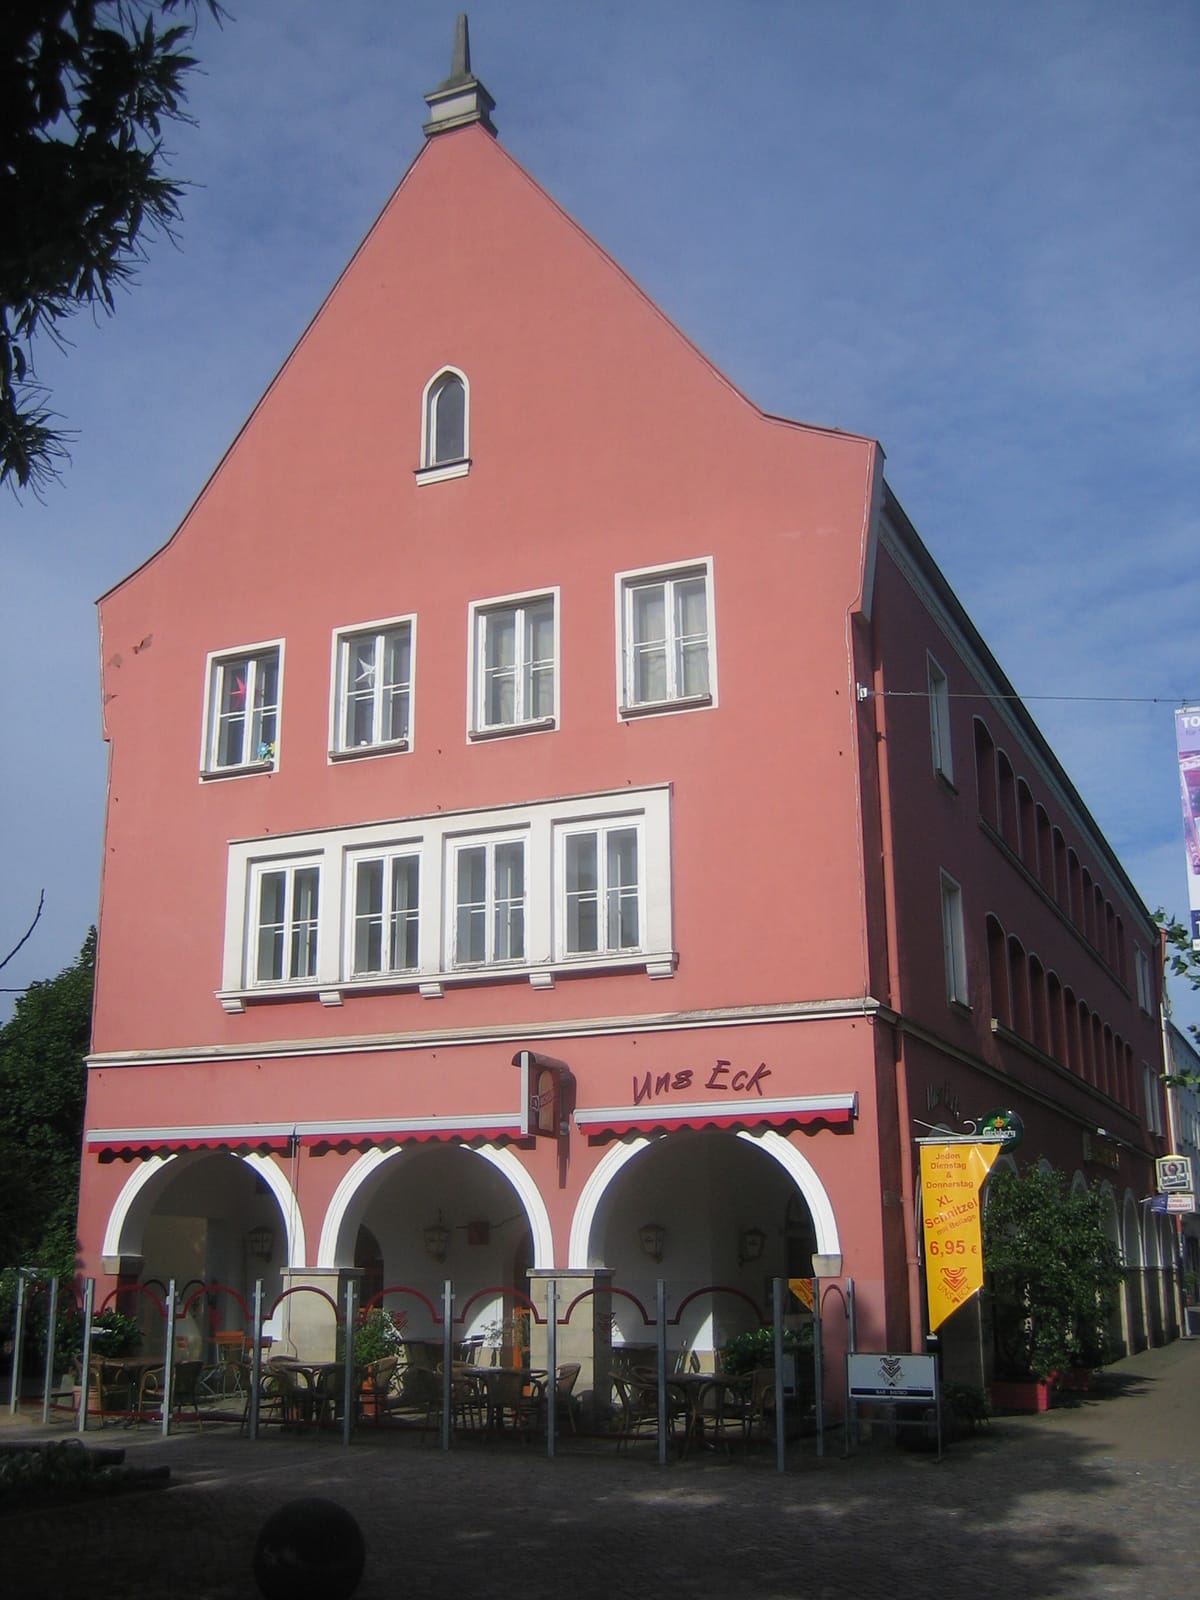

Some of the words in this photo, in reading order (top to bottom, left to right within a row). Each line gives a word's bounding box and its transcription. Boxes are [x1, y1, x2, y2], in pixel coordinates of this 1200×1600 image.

[633, 1069, 694, 1106] Uns
[705, 1059, 772, 1096] Eck
[982, 1126, 1016, 1139] Carlsberg
[935, 1152, 961, 1160] Jeden
[930, 1162, 967, 1170] Dienstag
[926, 1180, 974, 1189] Donnerstag
[936, 1194, 954, 1208] XL
[924, 1198, 978, 1229] Schnitzel
[929, 1240, 966, 1258] 6,95
